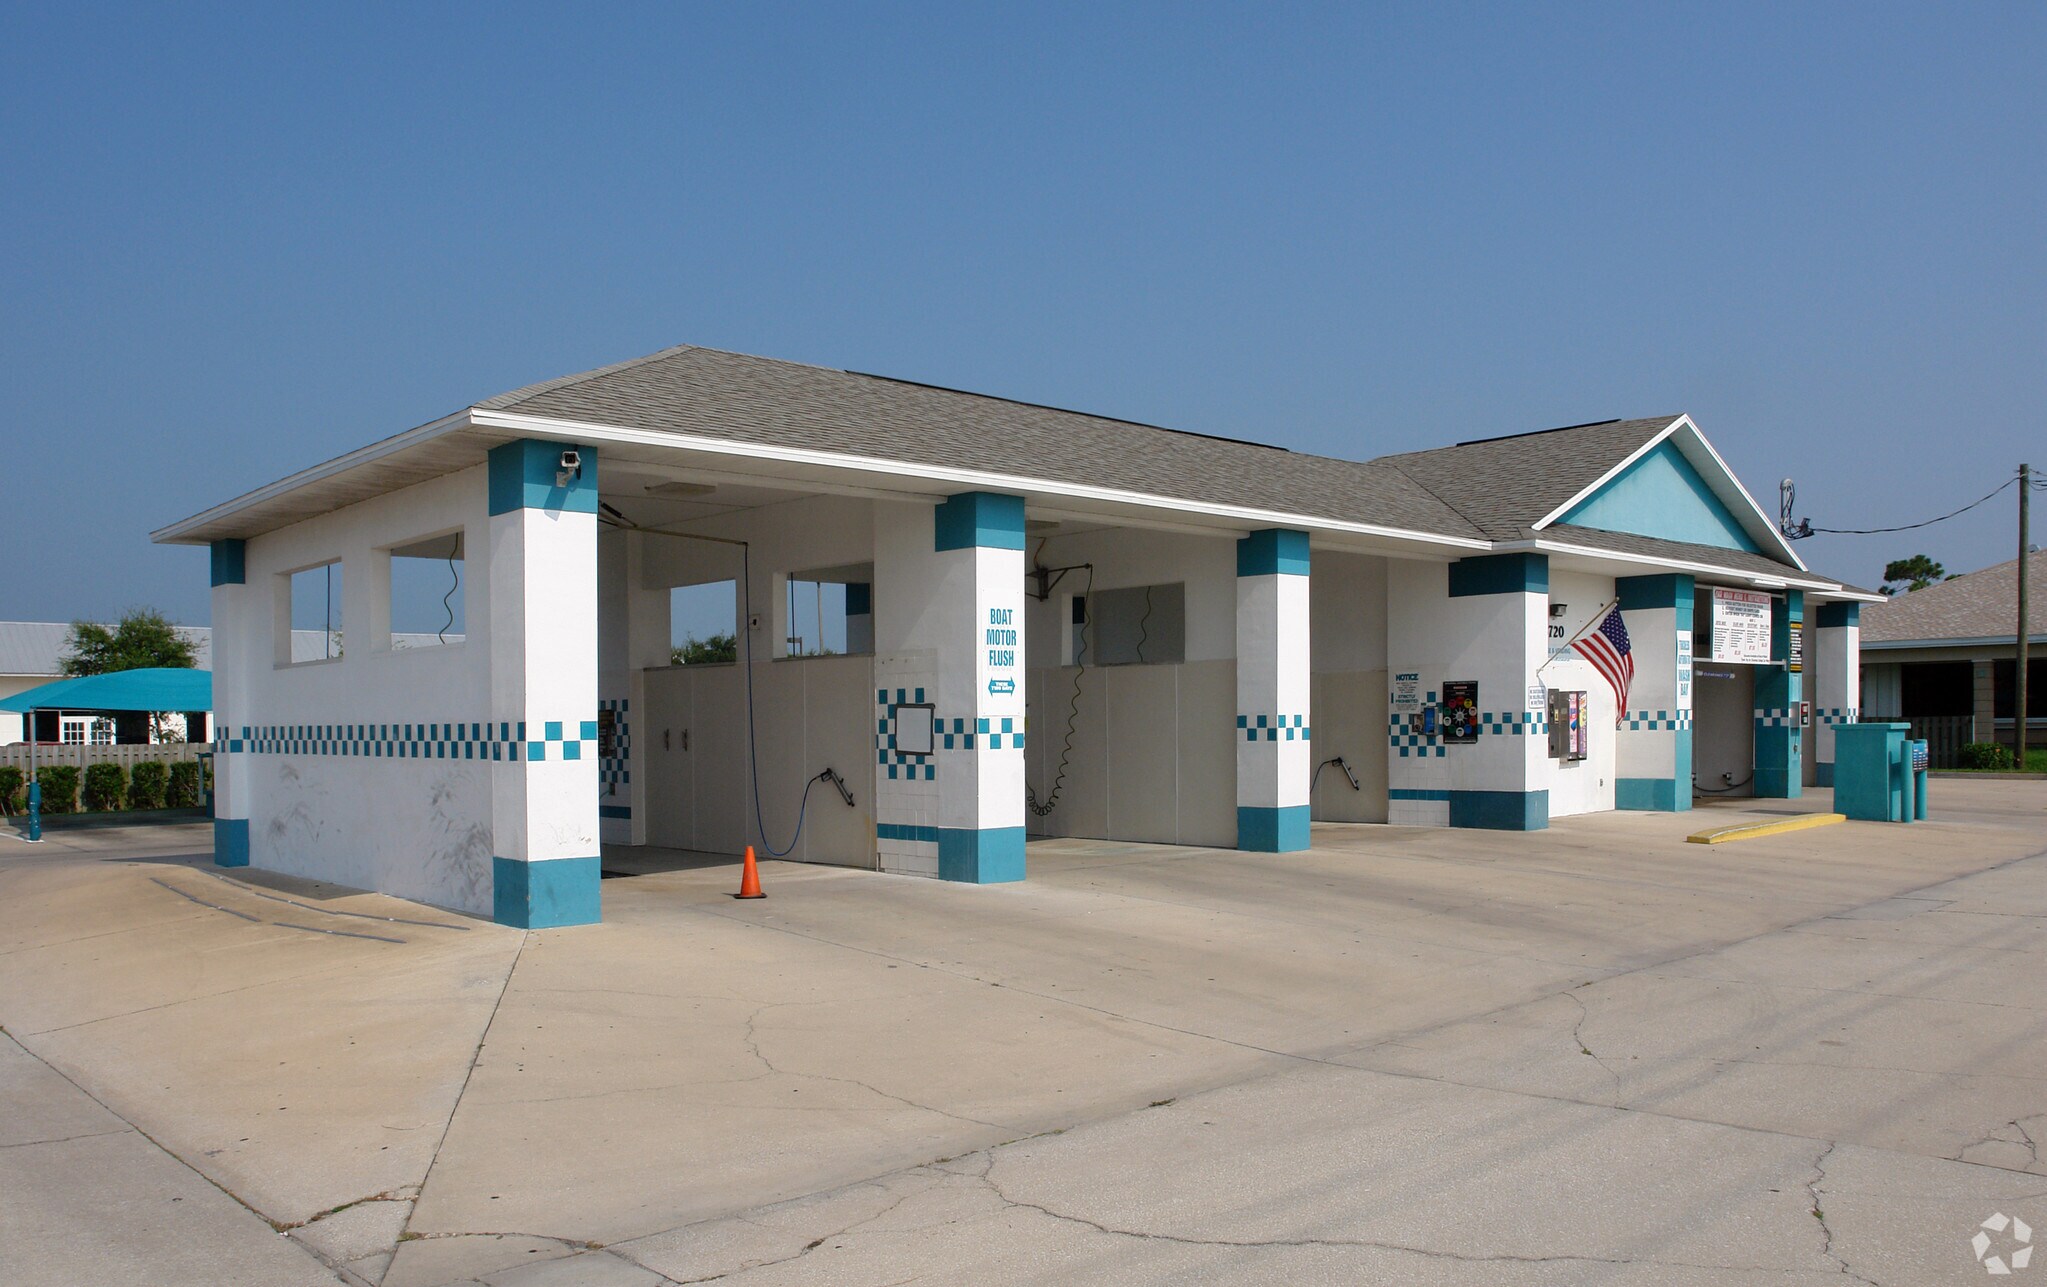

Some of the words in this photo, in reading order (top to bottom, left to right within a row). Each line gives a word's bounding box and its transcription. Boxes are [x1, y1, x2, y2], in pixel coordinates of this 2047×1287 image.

[990, 608, 1013, 625] BOAT
[986, 629, 1017, 646] MOTOR
[1548, 625, 1565, 638] 720
[989, 650, 1014, 666] FLUSH
[1395, 673, 1419, 681] NOTICE
